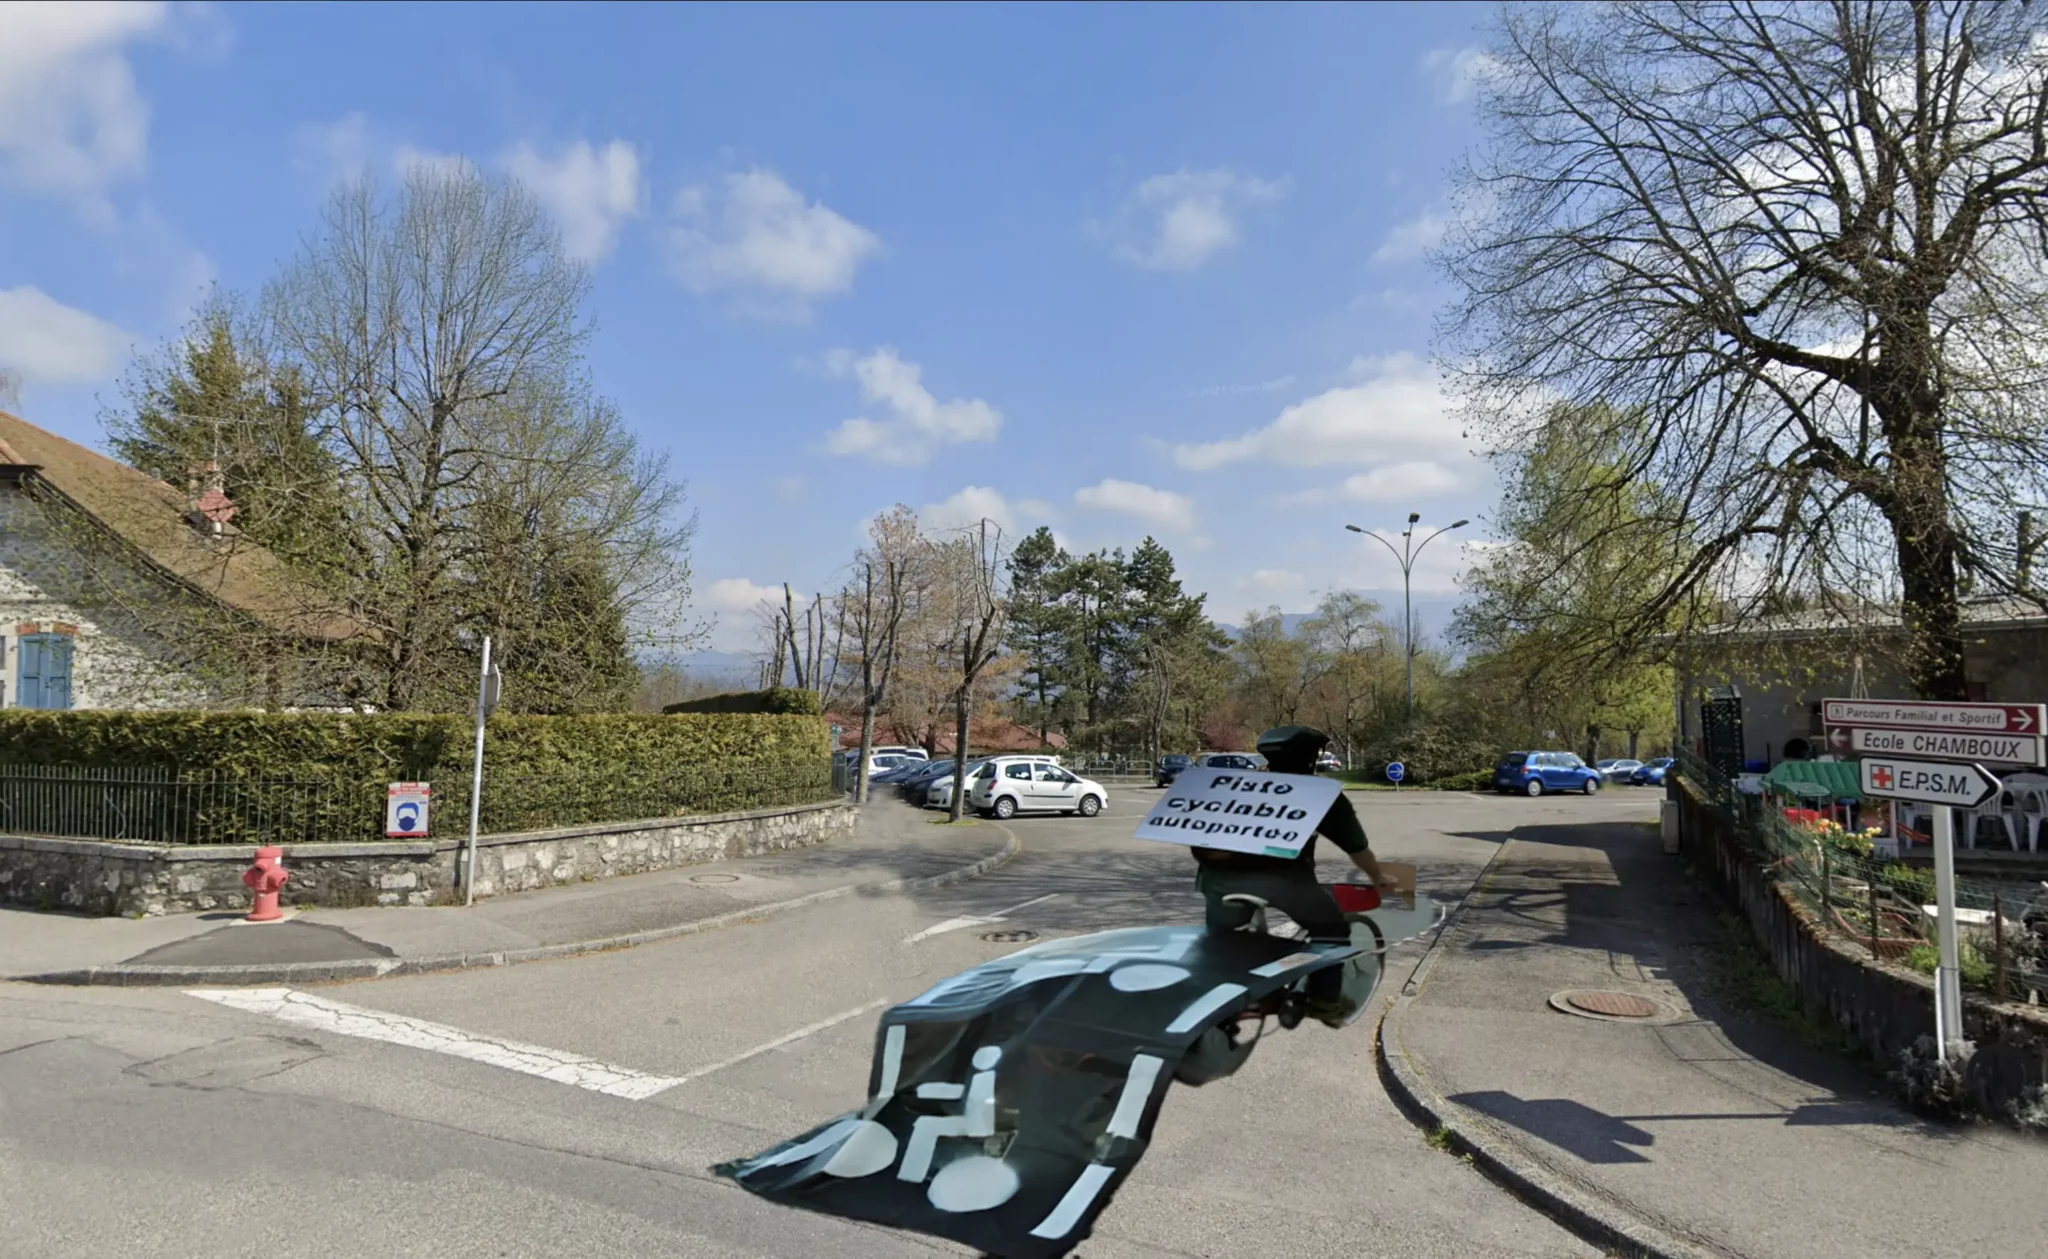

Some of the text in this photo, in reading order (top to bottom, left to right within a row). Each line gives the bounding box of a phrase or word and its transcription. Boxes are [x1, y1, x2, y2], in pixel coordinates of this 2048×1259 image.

[1846, 707, 2002, 725] Parcours Familial et Sportif
[1863, 732, 2021, 758] Ecole CHAMBOUX
[1899, 771, 1971, 796] E.P.S.M.
